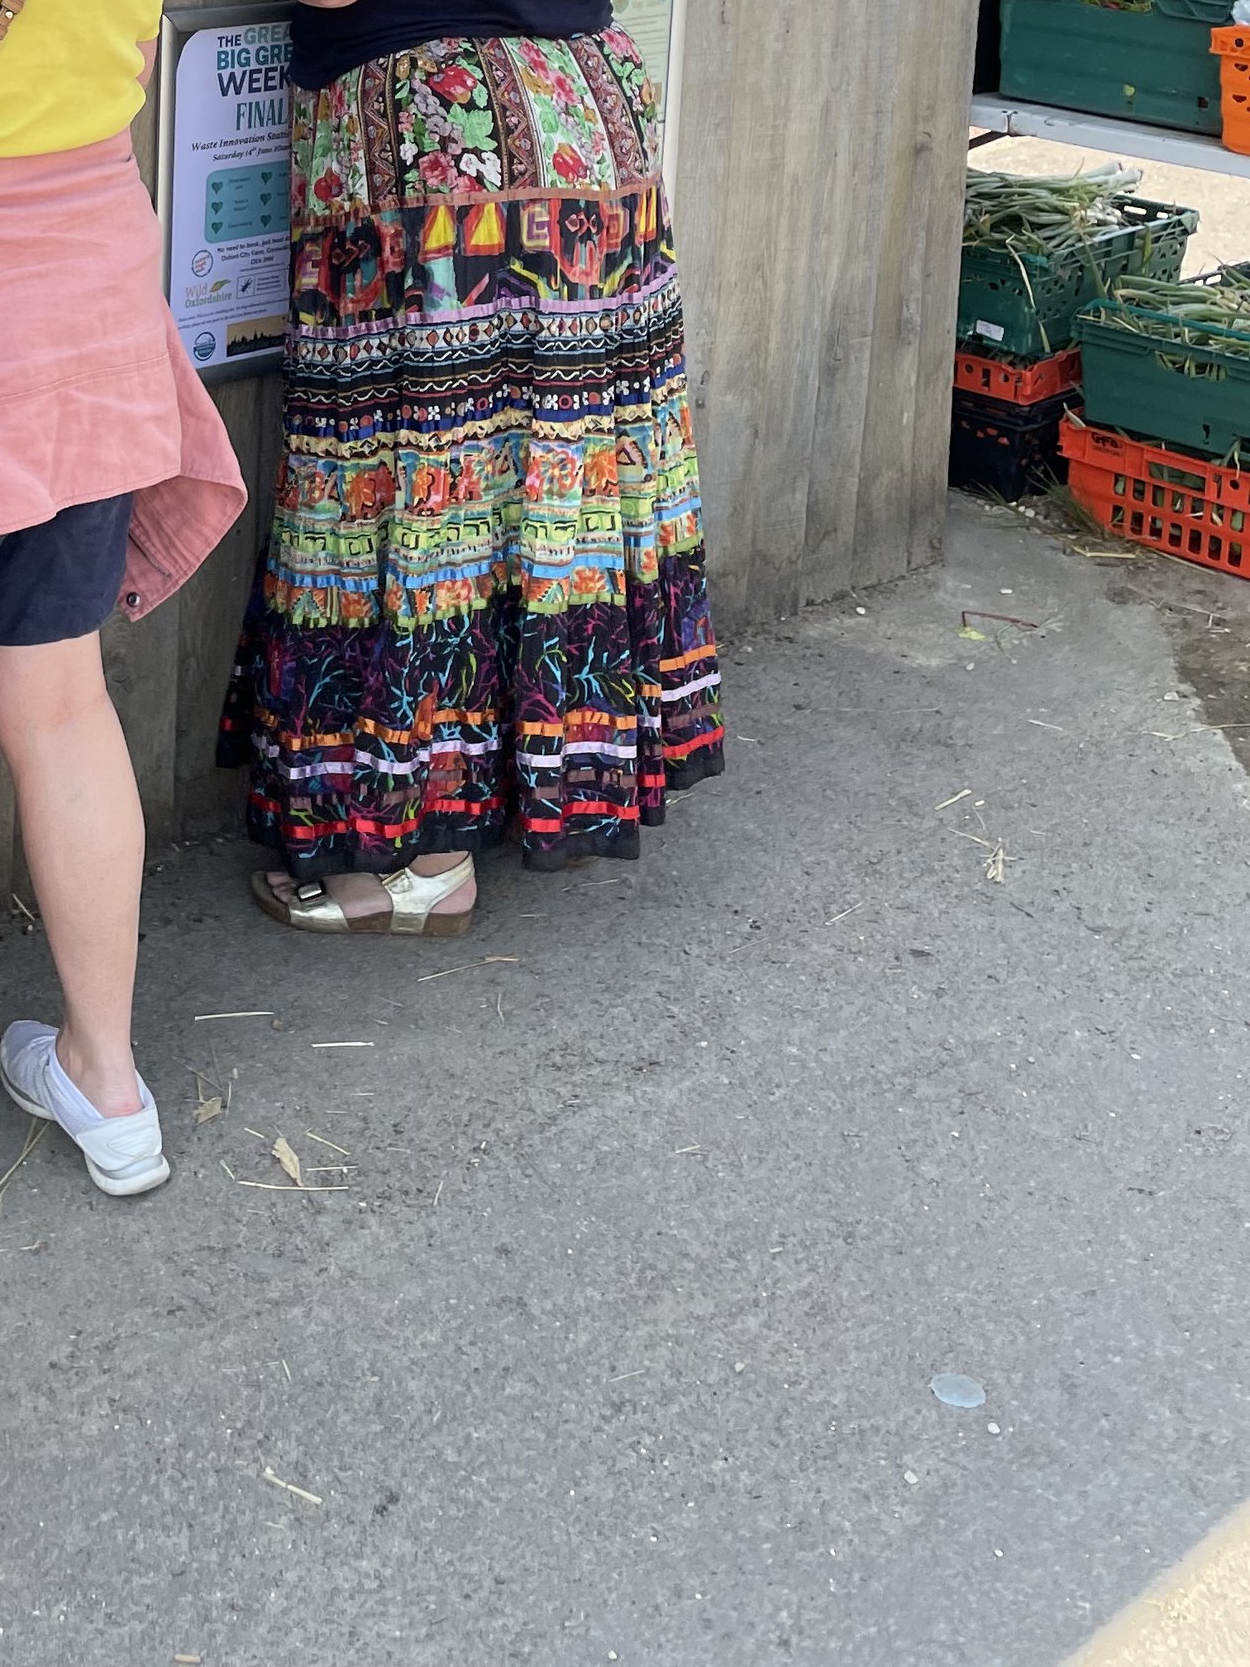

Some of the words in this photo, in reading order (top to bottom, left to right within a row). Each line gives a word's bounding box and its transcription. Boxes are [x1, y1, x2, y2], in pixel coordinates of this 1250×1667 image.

[217, 34, 242, 48] THE
[243, 23, 292, 45] GREA
[216, 47, 251, 71] BIG
[254, 42, 293, 66] GRE
[191, 141, 218, 152] Waste
[219, 134, 266, 149] Innovation
[213, 150, 244, 162] Saturday
[185, 282, 208, 299] Wild
[184, 292, 233, 309] Oxfordshire
